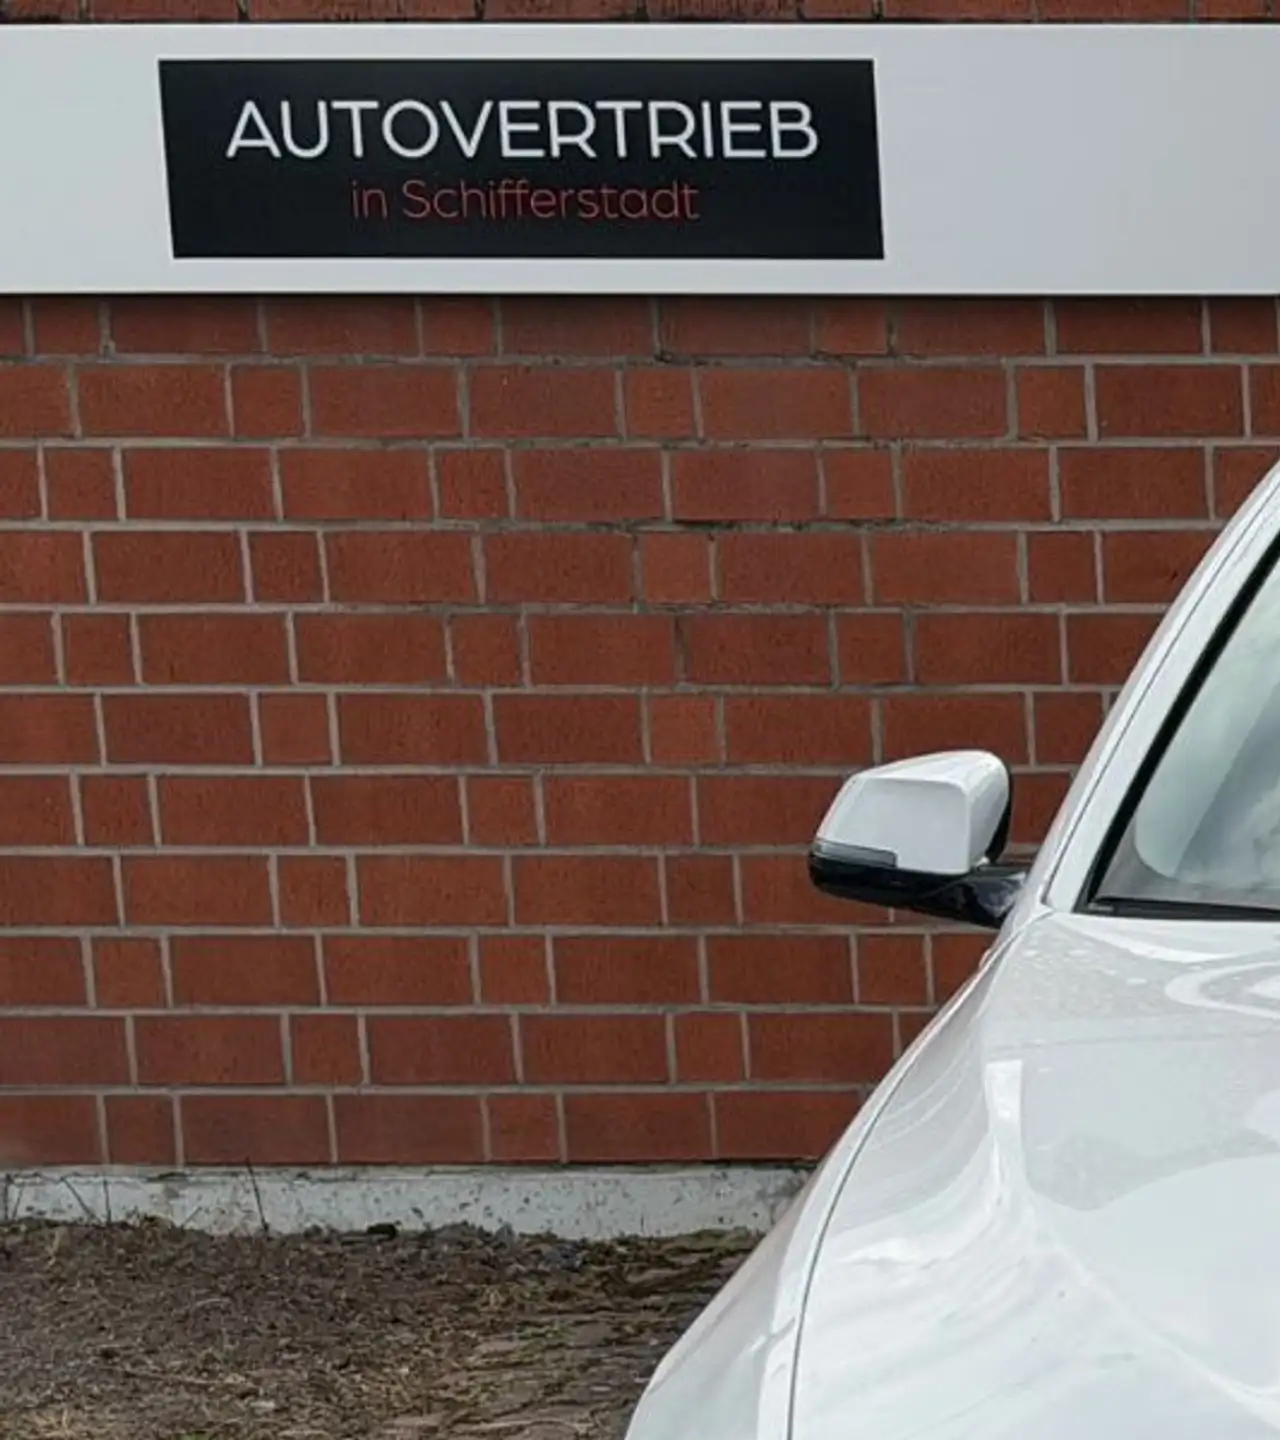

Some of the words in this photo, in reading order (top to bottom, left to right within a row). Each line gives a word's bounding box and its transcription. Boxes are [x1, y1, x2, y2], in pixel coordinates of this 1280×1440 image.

[226, 99, 819, 158] AUTOVERTRIEB
[350, 181, 389, 219] in
[402, 179, 699, 219] Schifferstadt
